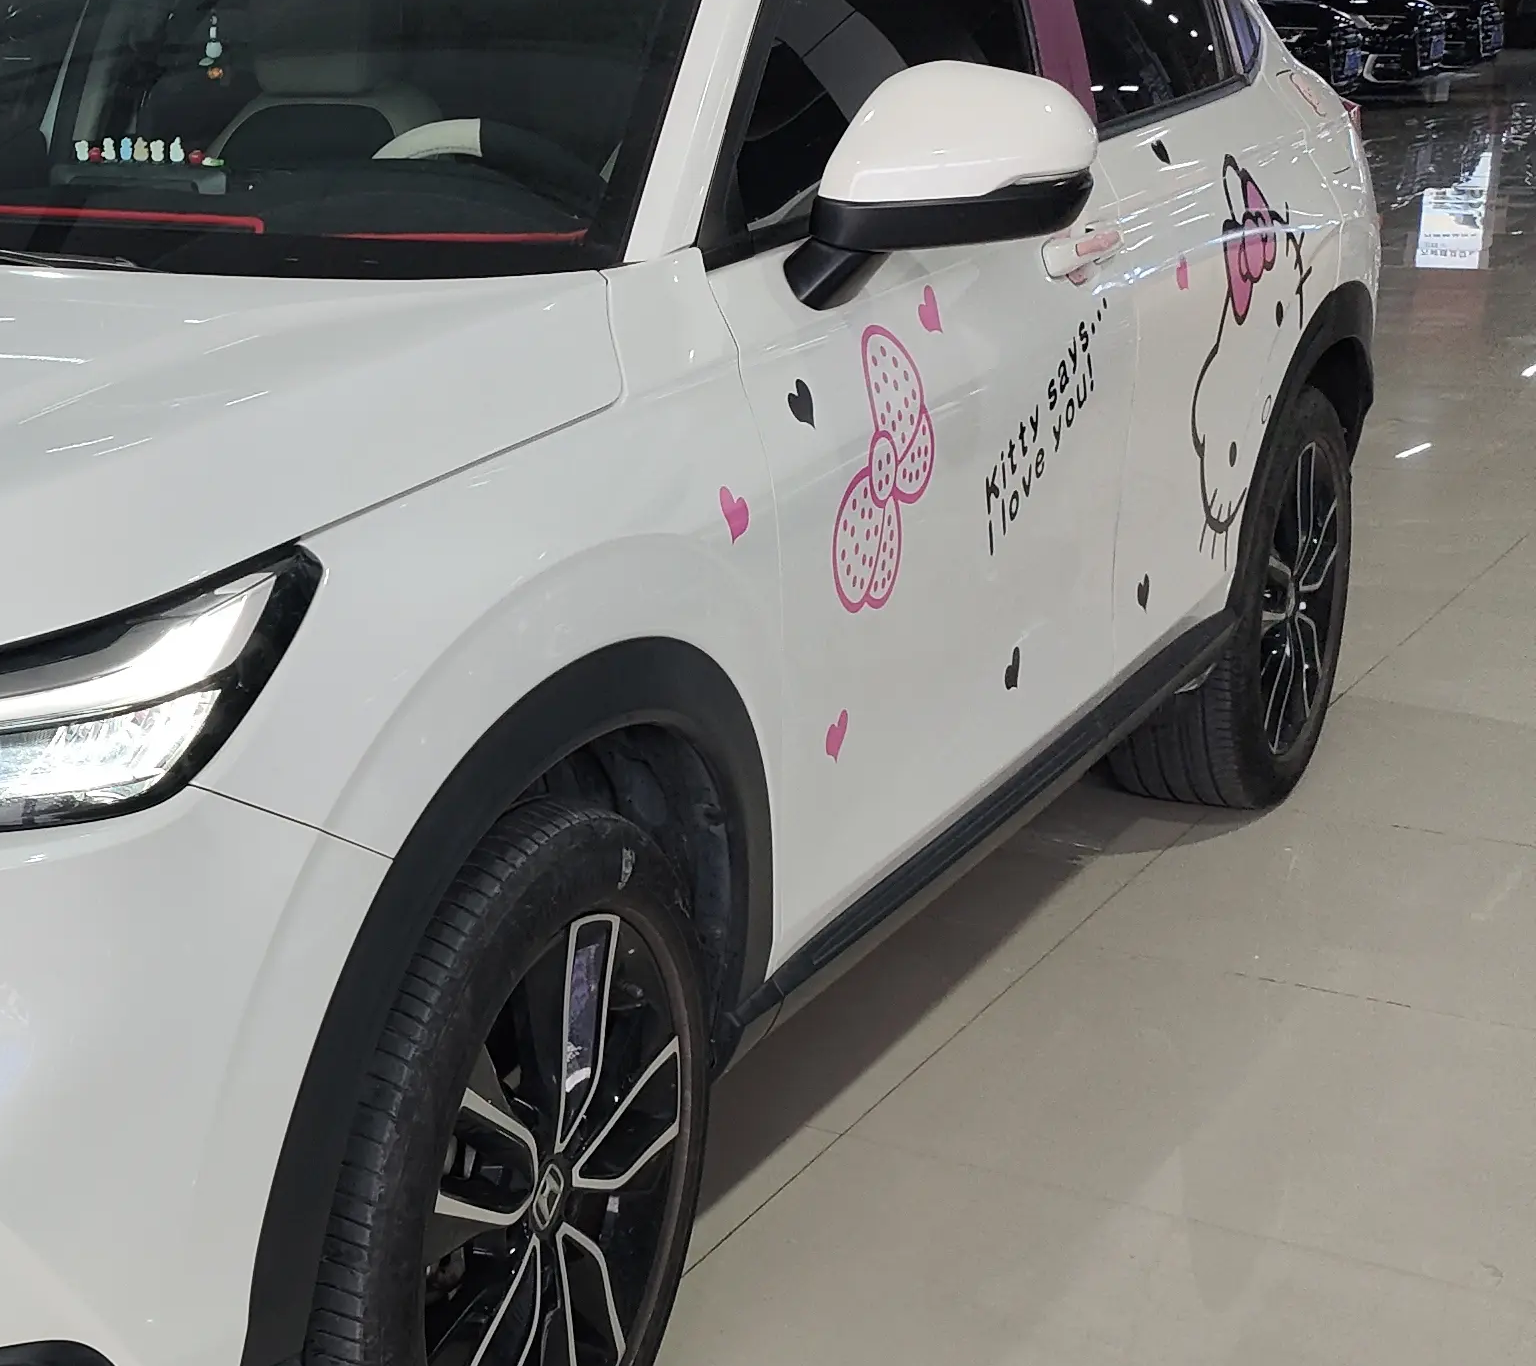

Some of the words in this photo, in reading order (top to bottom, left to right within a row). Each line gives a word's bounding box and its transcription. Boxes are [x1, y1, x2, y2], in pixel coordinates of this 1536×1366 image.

[985, 404, 1039, 515] Kitty
[1000, 447, 1046, 536] love
[1052, 352, 1095, 452] you!
